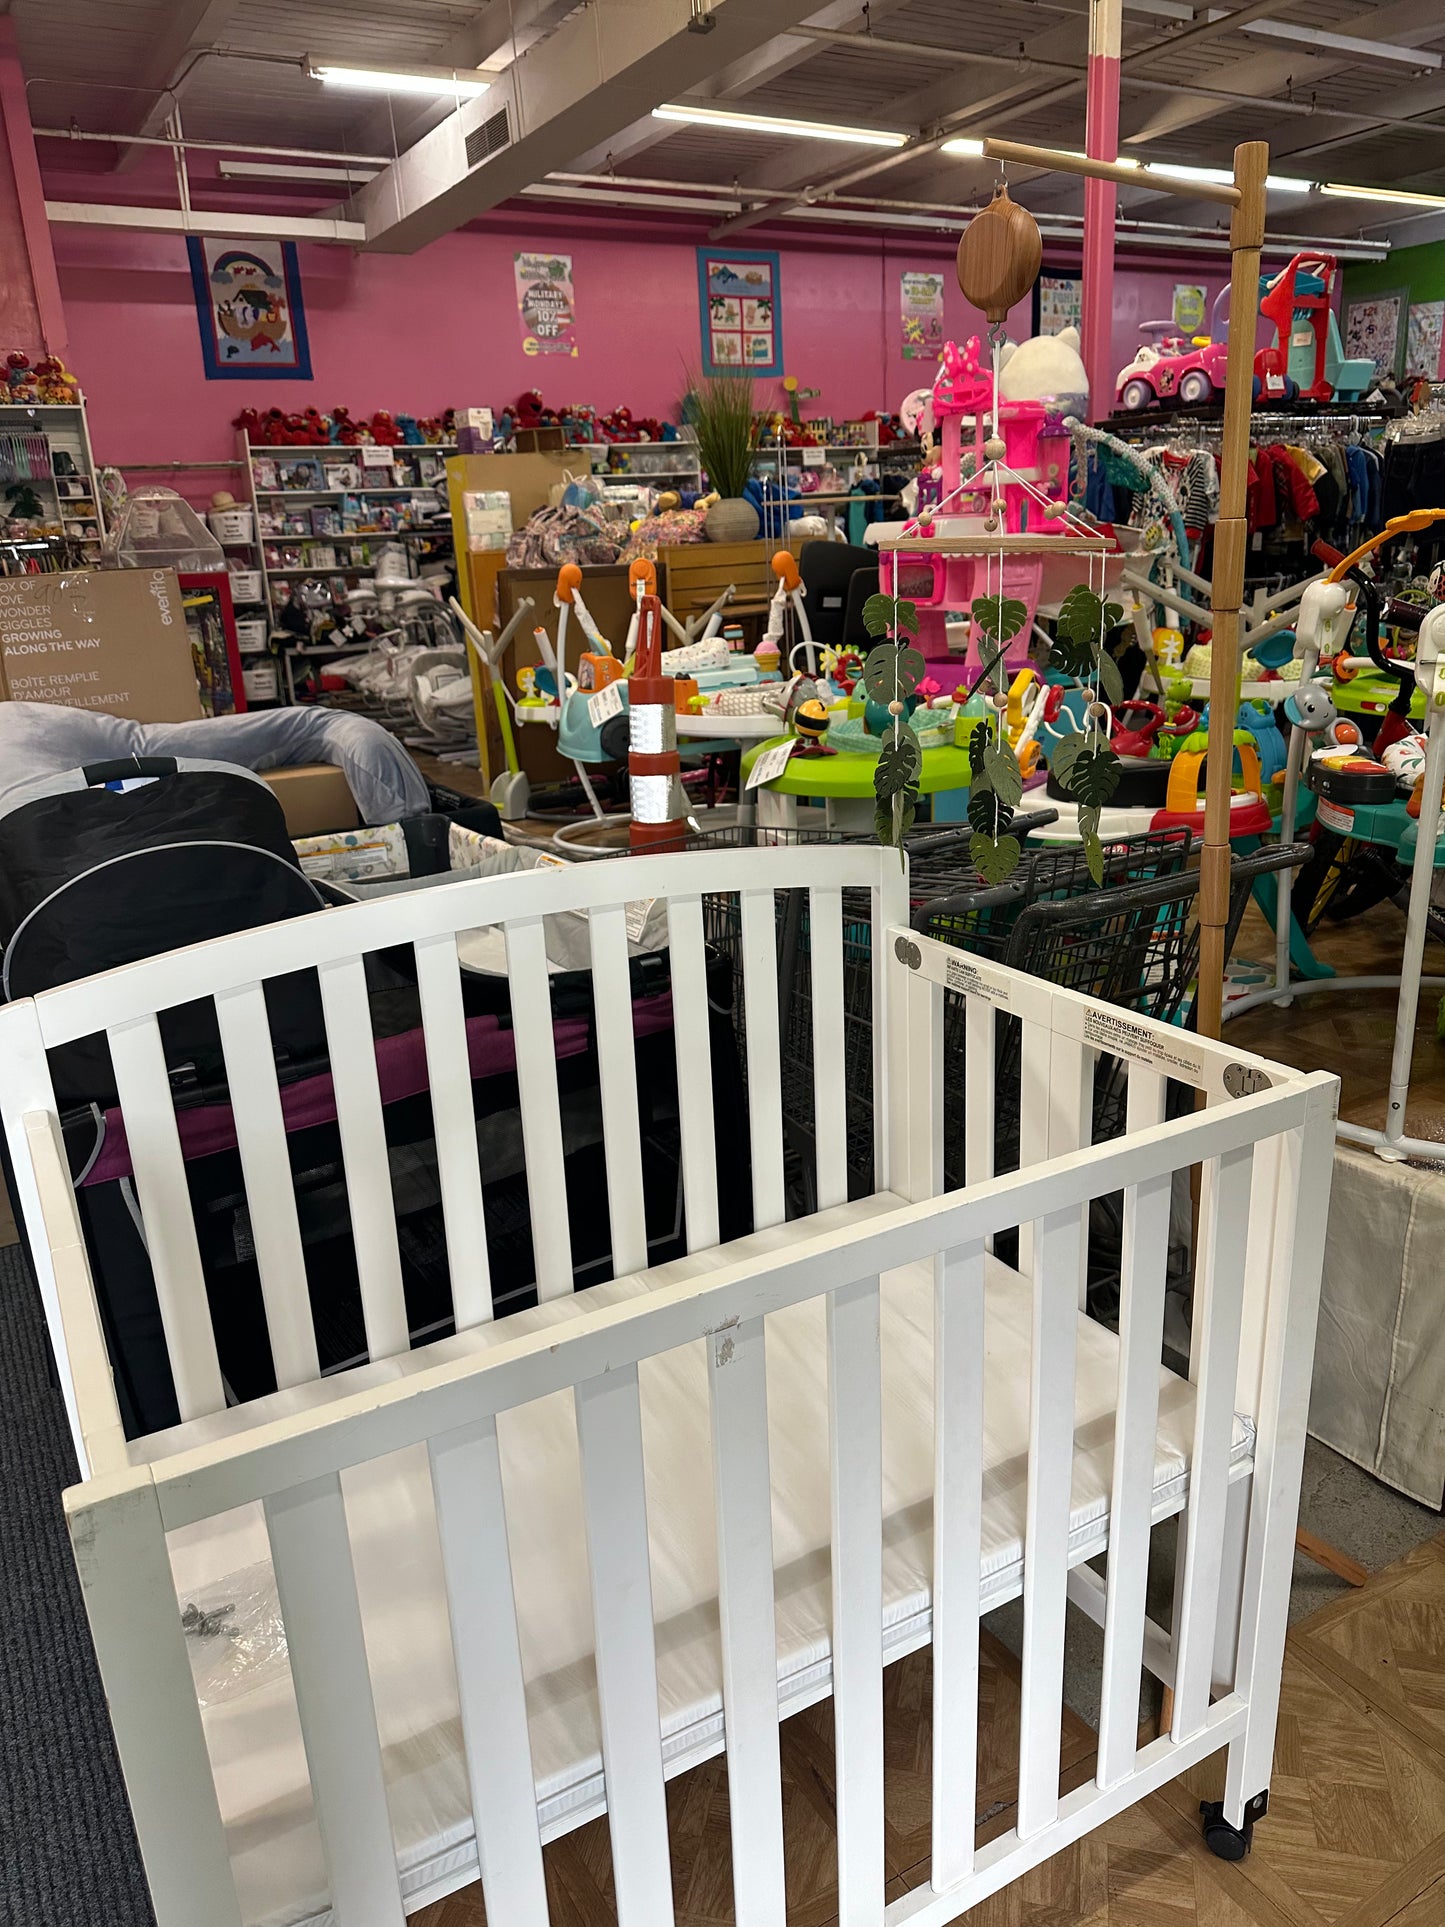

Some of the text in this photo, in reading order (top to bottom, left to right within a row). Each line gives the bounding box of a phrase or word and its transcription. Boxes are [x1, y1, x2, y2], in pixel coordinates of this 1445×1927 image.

[528, 289, 563, 299] MILITARY
[527, 299, 565, 309] MONDAYS
[537, 310, 558, 322] 10%
[537, 324, 559, 337] OFF
[0, 580, 36, 593] OX OF
[0, 594, 25, 606] OVE
[150, 570, 173, 626] evenflo
[0, 617, 53, 631] GIGGLES
[2, 629, 63, 644] GROWING
[5, 638, 101, 656] ALONG THE WAY
[11, 671, 100, 689] BOÎTE REMPLIE
[13, 687, 72, 701] D'AMOUR
[1092, 1011, 1155, 1041] AVERTISSEMENT:
